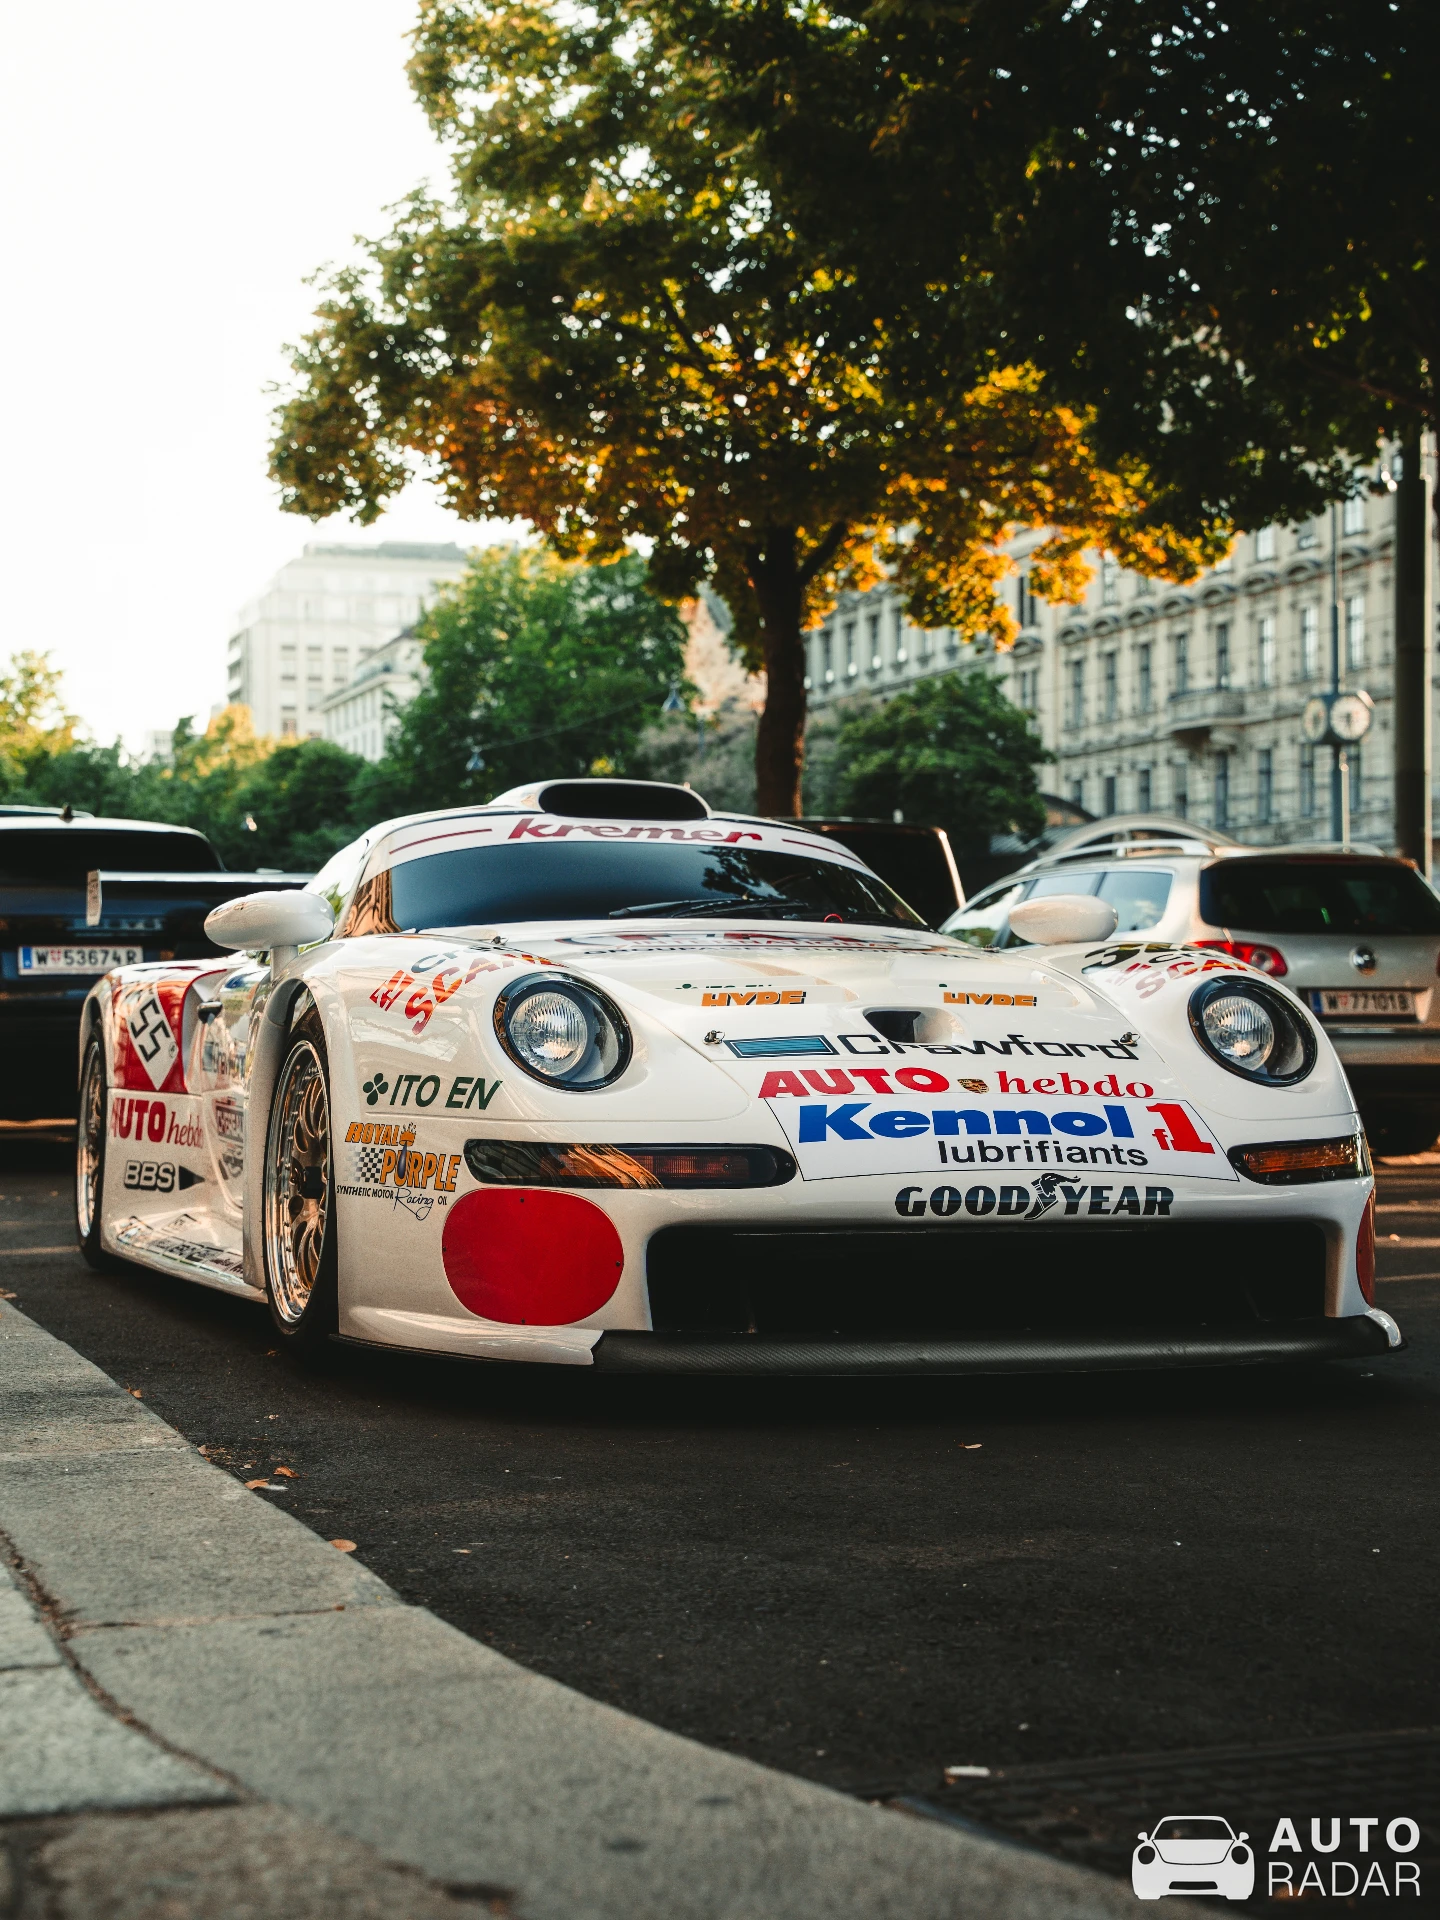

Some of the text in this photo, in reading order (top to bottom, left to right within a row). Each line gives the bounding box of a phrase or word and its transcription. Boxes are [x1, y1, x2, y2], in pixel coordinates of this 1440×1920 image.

[508, 818, 763, 843] kremer
[35, 949, 49, 966] W
[837, 1034, 1139, 1060] Crawford
[389, 1074, 503, 1110] ITO EN
[757, 1067, 1154, 1099] AUTO hebdo
[111, 1097, 167, 1143] AUTO
[344, 1121, 401, 1147] ROYAL
[798, 1103, 1135, 1143] Kennol
[938, 1140, 1149, 1166] lubrifiants
[124, 1160, 176, 1193] BBS
[379, 1148, 463, 1192] PURPLE
[336, 1184, 448, 1221] SYNTHETIC MOTOR Racing OIL
[895, 1185, 1175, 1217] GOOD YEAR
